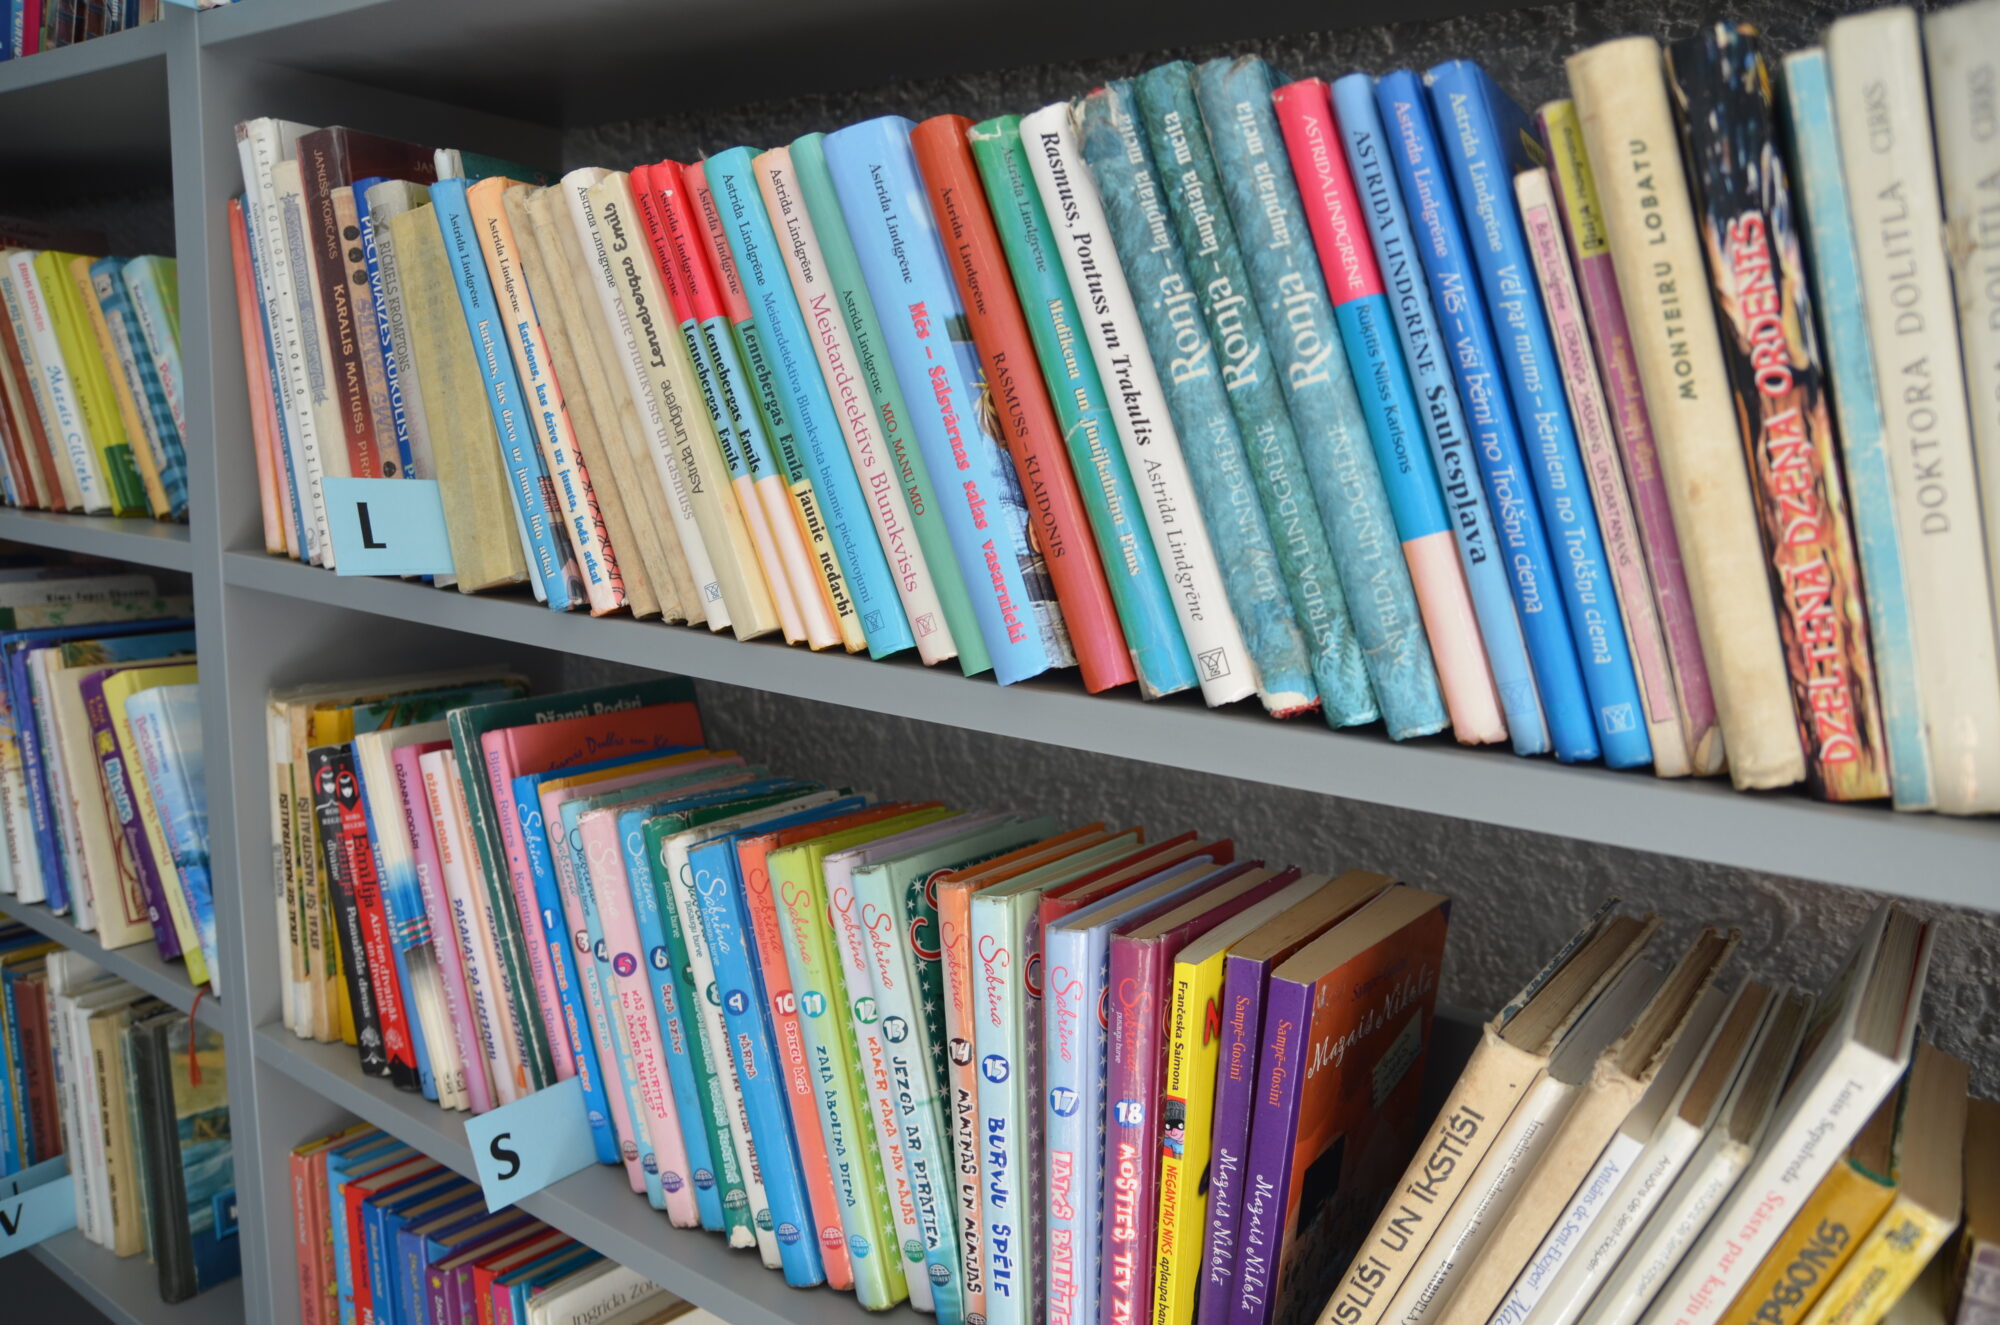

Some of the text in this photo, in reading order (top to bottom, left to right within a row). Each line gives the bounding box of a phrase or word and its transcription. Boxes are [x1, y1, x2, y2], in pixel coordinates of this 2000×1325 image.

[333, 284, 354, 354] KARALIS
[638, 192, 722, 422] Astrida Lennebergas
[1018, 198, 1081, 381] Lindgrēne Madikena
[1162, 109, 1262, 393] Ronja laupītāja meita
[1233, 99, 1334, 394] Ronja laupītāja meita
[1302, 113, 1335, 190] ASTRIDA
[1383, 403, 1412, 475] Karlsons
[1628, 138, 1699, 402] MONTEIRU LOBATU
[1863, 79, 1950, 537] DOKTORA DOLITLA CIRKS
[388, 296, 411, 372] KROMPTONS
[449, 212, 556, 579] Astrida Lindgrēne atkal
[488, 217, 603, 586] Astrida Lindgrēne atkal
[604, 201, 704, 495] Astrida Lennebergas Emīls
[674, 234, 743, 423] Lindgrēne Lennebergas
[722, 172, 871, 605] Astrida Lindgrēne Blumkvista bīstamie piedzīvojumi
[769, 168, 918, 594] Astrida Lindgrēne Meistardetektīvs Blumkvists
[940, 187, 1066, 559] Astrida Lindgrēne RASMUSS KLAIDONIS
[1040, 131, 1206, 623] Rasmuss, Pontuss un Trakulis Astrida Lindgrēne
[1152, 271, 1212, 387] Ronja
[1353, 129, 1488, 567] ASTRIDA LINDGRĒNE Saulespļava
[1393, 100, 1544, 615] Astrida Lindgrēne Mēs visi Trokšņu ciema
[1449, 92, 1613, 667] Astrida Lindgrēne Vēl mums bērniem Trokšņu ciema
[697, 187, 854, 619] Astrida Lindgrēne Lennebergas jaunie nedarbi
[842, 289, 925, 517] Astrida Lindgrēne MANU MIO
[869, 162, 1028, 645] Astrida Lindgrēne Mēs salas vasarnieki
[356, 502, 387, 549] L
[1727, 209, 1858, 764] DZELTENĀ ORDENIS
[514, 870, 535, 938] Kapteinis
[517, 803, 545, 878] Sabrina
[627, 830, 657, 914] Sabrina
[695, 868, 730, 955] Sabrina
[749, 867, 783, 955] Sabrina
[781, 880, 812, 966] Sabrina
[833, 887, 868, 972] Sabrina
[861, 902, 895, 991] Sabrina
[941, 920, 968, 1015] Sabrina
[978, 934, 1011, 1029] Sabrina
[983, 1057, 1007, 1081] 15
[1050, 965, 1084, 1064] Sabrina
[1118, 975, 1153, 1074] Sabrina
[1171, 979, 1189, 1092] Frančeska Saimona
[1228, 994, 1251, 1082] Sampē-Gosinī
[1266, 1018, 1294, 1108] Sampē-Gosinī
[1307, 970, 1436, 1079] Mazais Nikolā
[489, 1132, 521, 1180] S
[815, 1044, 857, 1209] ZAĻĀ ĀBOLIŅA DIENA
[866, 1034, 917, 1228] KAMĒR NAV MĀJĀS
[892, 1055, 942, 1251] JEZGA AR PIRĀTIEM
[1051, 1089, 1080, 1115] 17
[1115, 1101, 1144, 1124] 18
[957, 1087, 983, 1295] MĀMIŅAS UN MŪMIJAS
[986, 1116, 1015, 1298] BURVJU SPĒLE
[1051, 1149, 1075, 1221] LAIKS
[1111, 1141, 1139, 1295] MOSTIES, TEV
[1156, 1164, 1178, 1303] NEGANTAIS NIKS aplaupa
[1209, 1147, 1238, 1288] Mazais Nikolā
[1240, 1173, 1275, 1316] Mazais Nikolā
[1379, 1103, 1486, 1253] UN ĪKSTĪŠI
[1525, 1158, 1622, 1292] Antuāns Sent-Ekziperī
[1688, 1116, 1836, 1318] Sepulveda Stāsts par kaiju
[1752, 1215, 1852, 1325] PSONS
